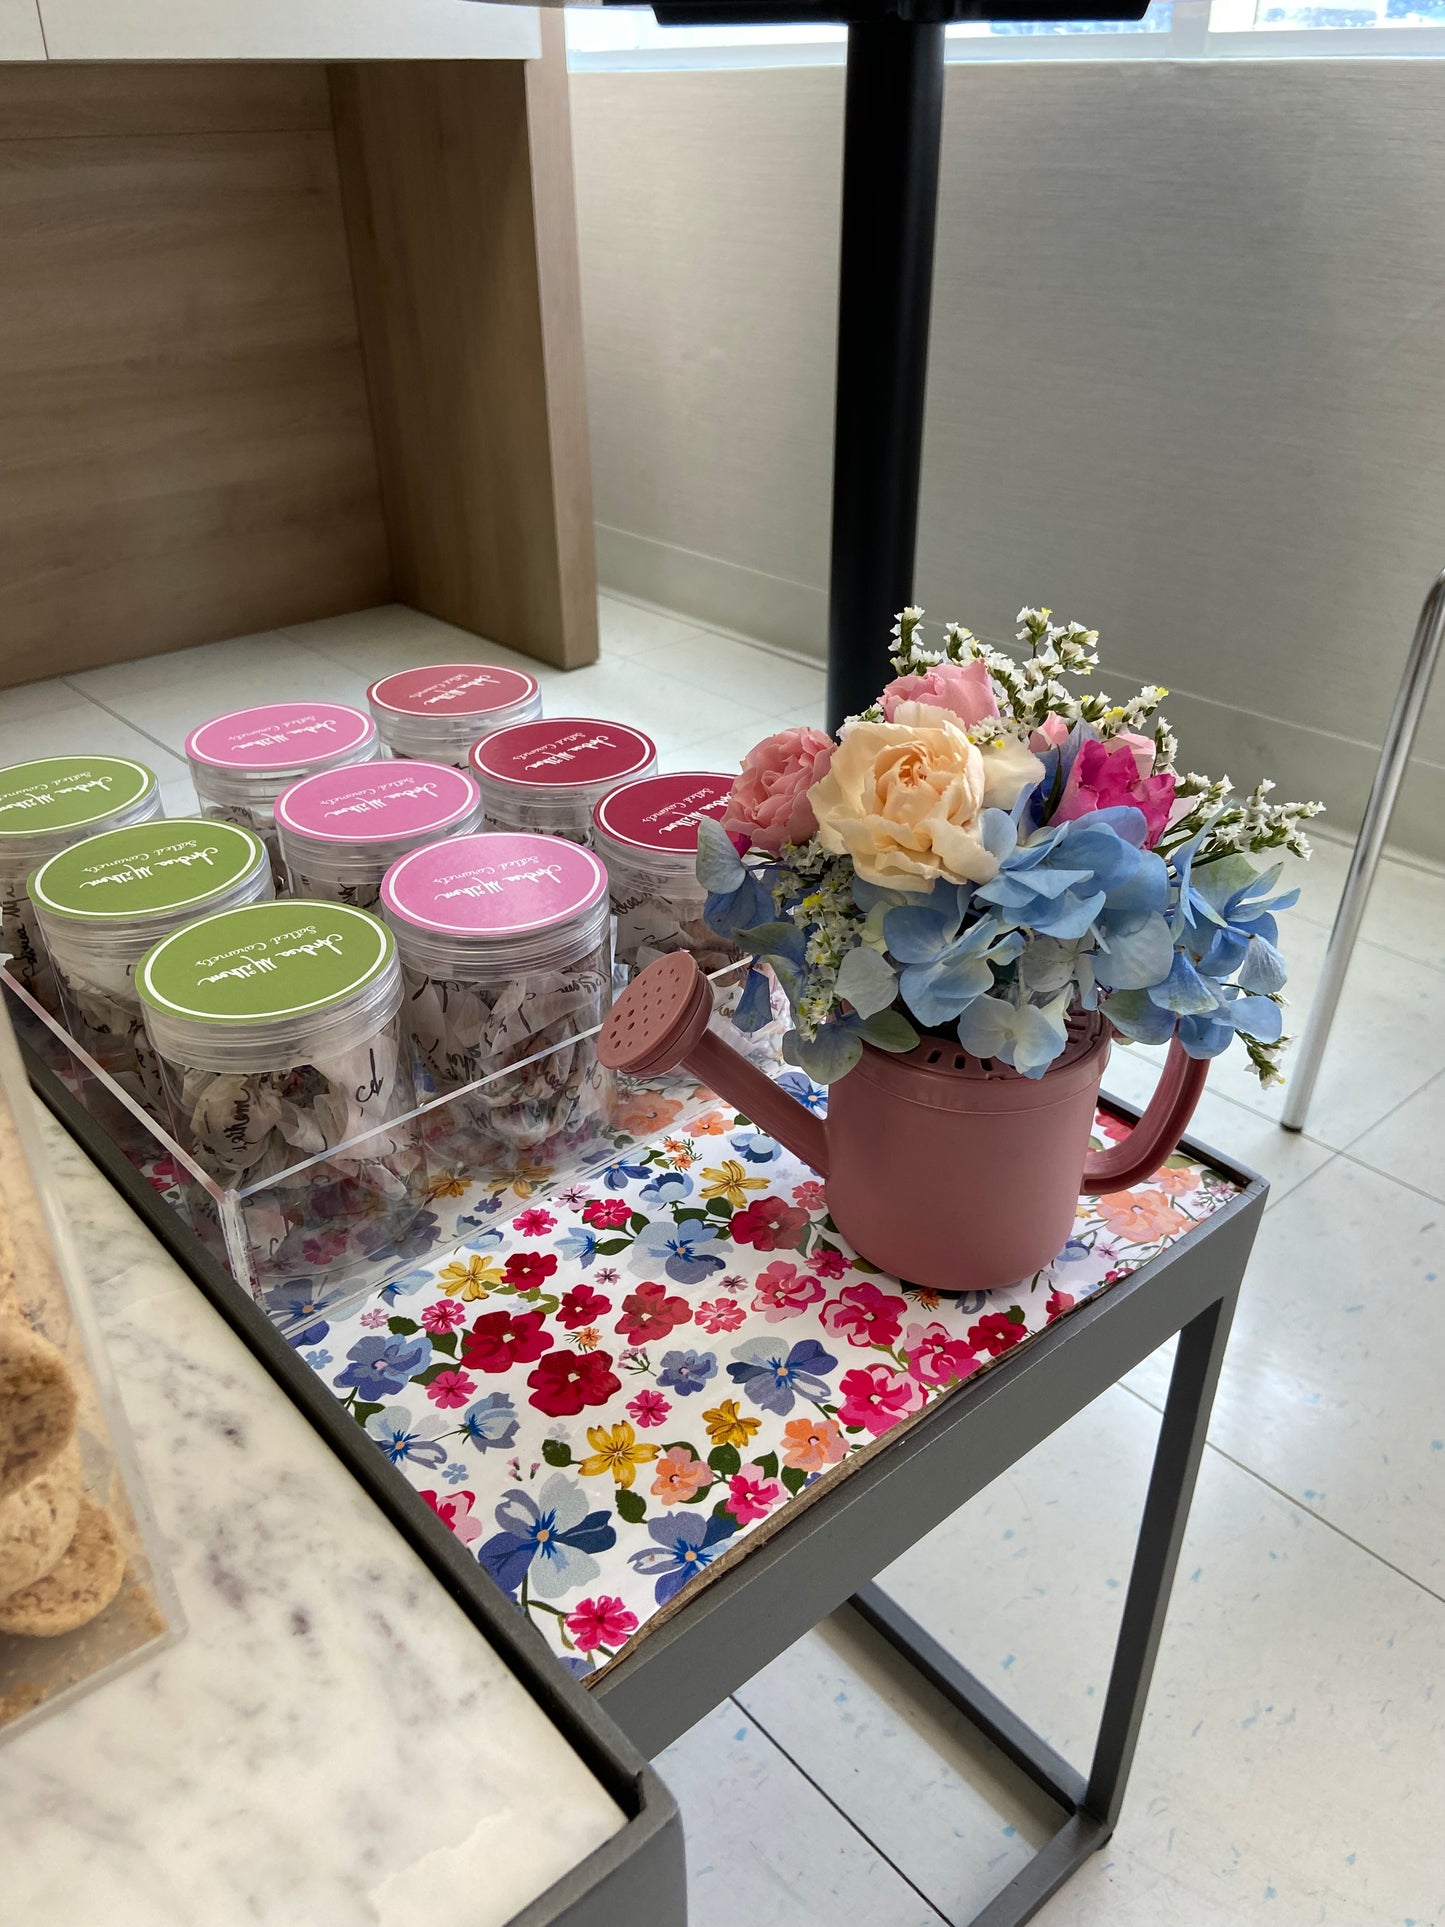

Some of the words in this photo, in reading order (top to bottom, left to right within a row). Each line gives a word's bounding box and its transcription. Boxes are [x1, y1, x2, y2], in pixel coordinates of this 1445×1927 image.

[51, 771, 91, 786] Salted
[54, 776, 112, 792] Andrea
[377, 776, 415, 790] Salted
[320, 788, 376, 806] Caramels
[384, 782, 438, 798] Andrea
[153, 840, 197, 855] Salted
[154, 847, 218, 866] Andrea
[82, 853, 149, 874] Caramels
[497, 855, 539, 868] Salted
[433, 866, 495, 885] Caramels
[502, 864, 562, 884] Andrea
[270, 925, 317, 944] Salted
[275, 934, 343, 957] Andrea
[195, 942, 267, 968] Caramels
